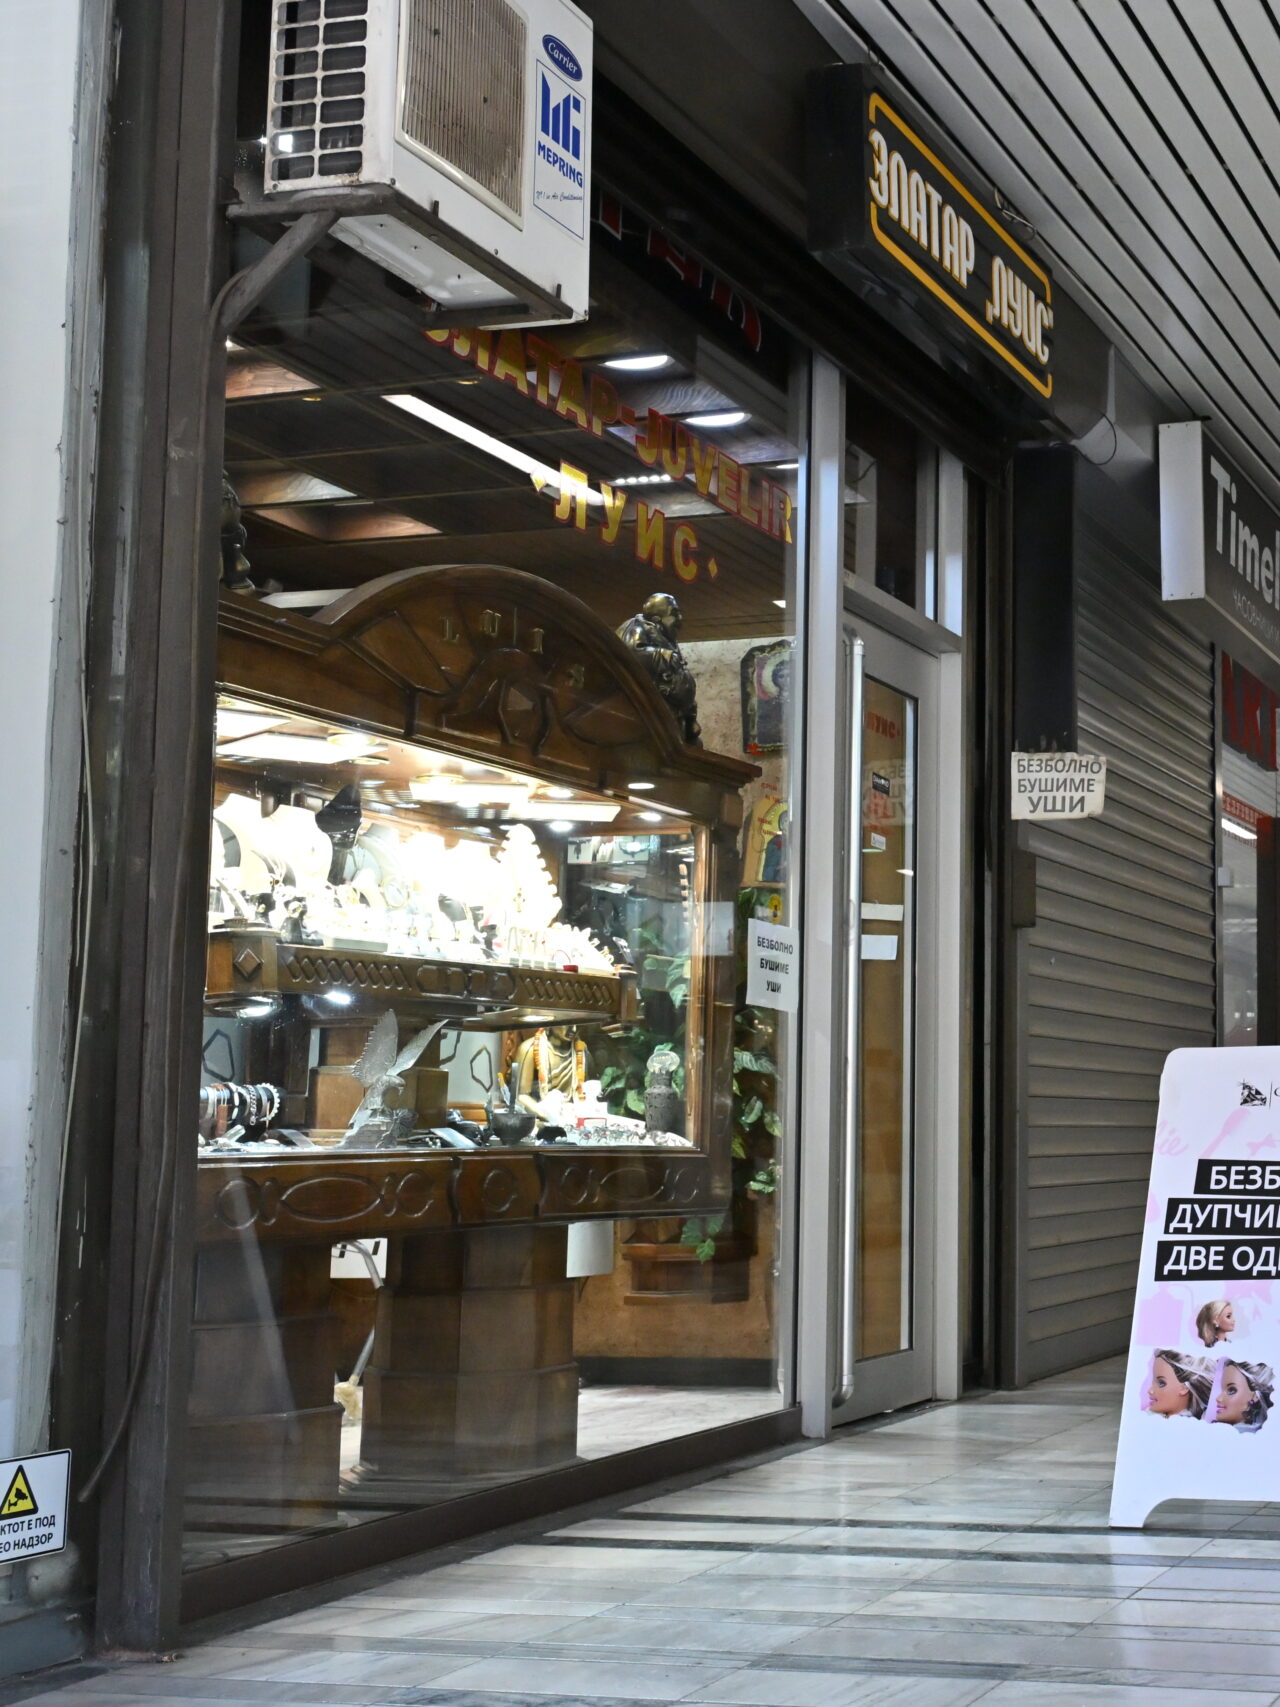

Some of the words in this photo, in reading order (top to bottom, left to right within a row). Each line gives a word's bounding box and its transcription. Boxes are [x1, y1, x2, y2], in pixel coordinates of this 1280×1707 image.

[547, 42, 579, 75] Carrier
[537, 140, 583, 189] MEPRING
[868, 128, 976, 289] ЗЛАТАР
[553, 459, 699, 585] ЛУИС
[1017, 758, 1102, 774] БЕЗБОЛНО
[1018, 777, 1096, 793] БУШИМЕ
[1028, 795, 1085, 814] УШИ
[757, 935, 794, 955] БЕЗБОЛНО
[760, 957, 790, 975] БУШИМЕ
[766, 980, 782, 993] УШИ
[1163, 1246, 1225, 1276] ДВЕ
[27, 1519, 34, 1531] Е
[35, 1514, 56, 1529] ПОД
[13, 1532, 53, 1551] НАДЗОР
